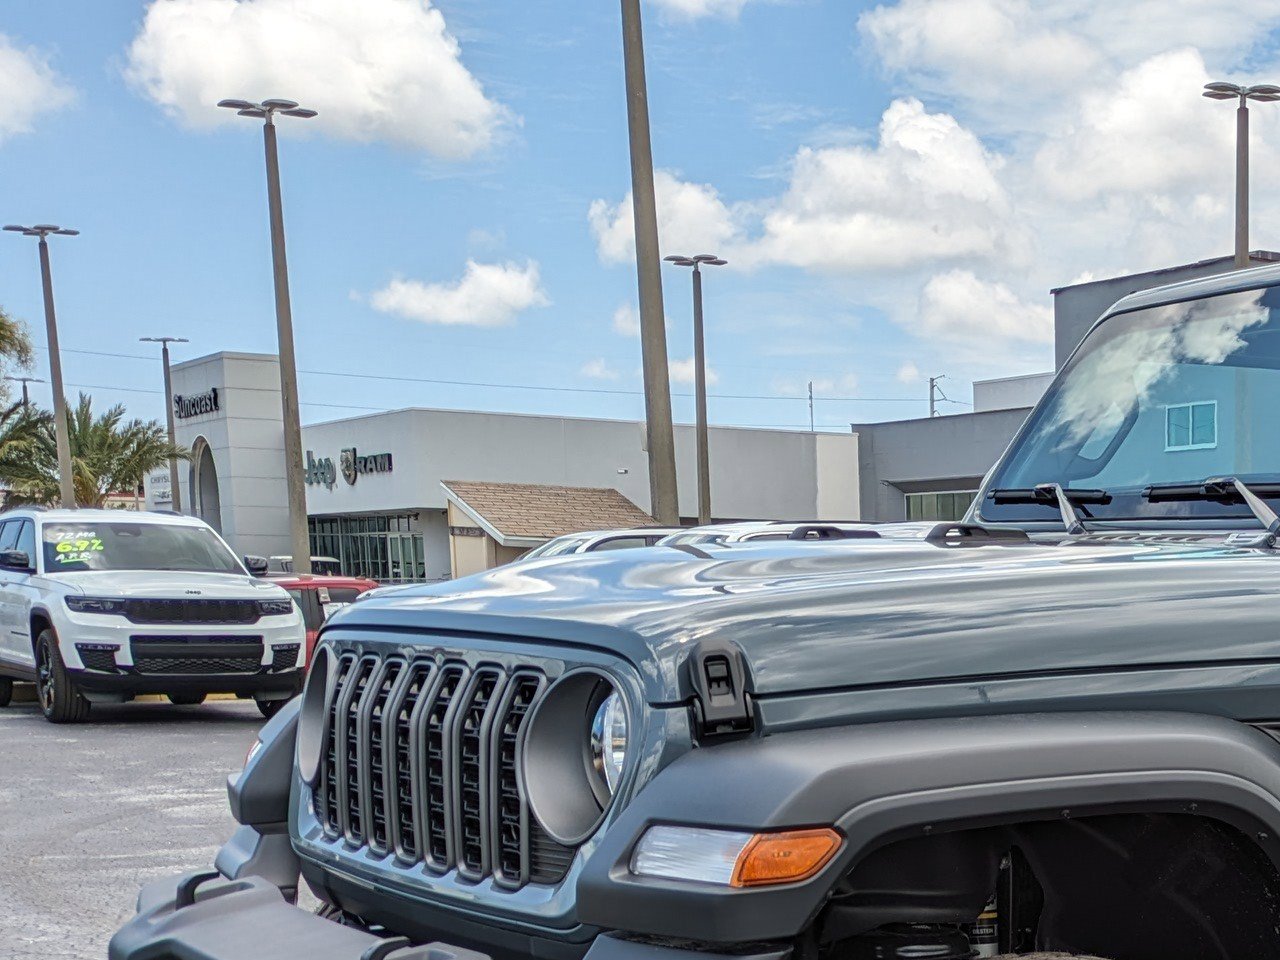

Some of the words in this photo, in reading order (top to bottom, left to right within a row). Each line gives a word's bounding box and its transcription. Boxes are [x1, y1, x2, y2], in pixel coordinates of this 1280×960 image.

[174, 387, 219, 419] Suncoast
[356, 452, 393, 475] RAM
[56, 539, 104, 552] 6.9%
